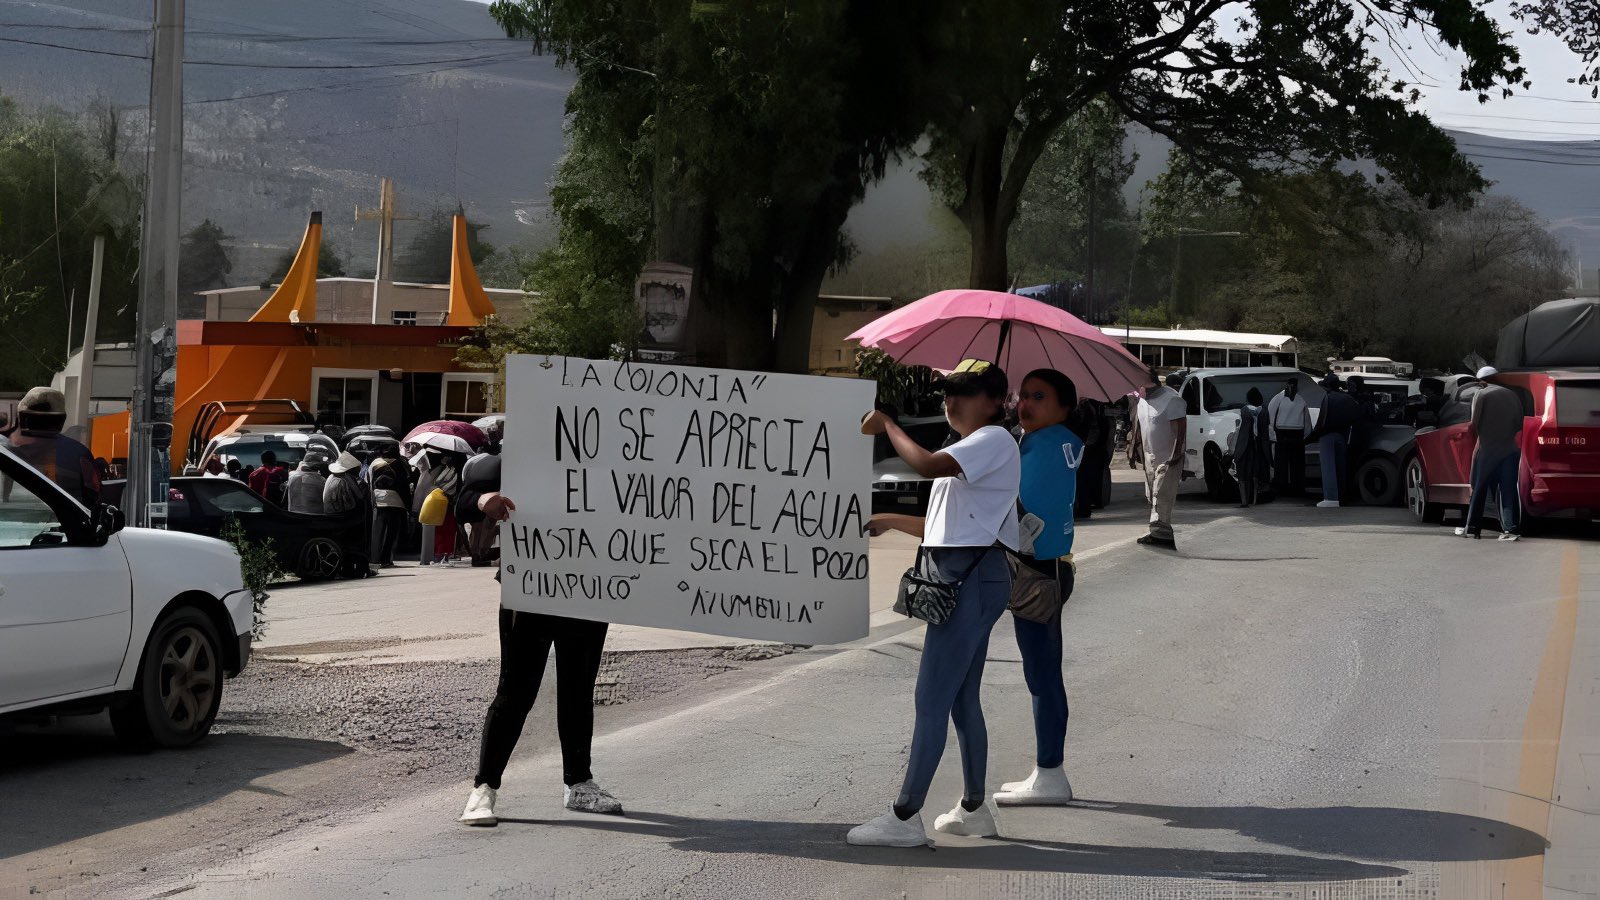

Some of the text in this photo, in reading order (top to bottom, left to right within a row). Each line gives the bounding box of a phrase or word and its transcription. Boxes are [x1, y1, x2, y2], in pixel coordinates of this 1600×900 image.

[555, 406, 831, 480] NO SE APRECIA
[566, 468, 864, 540] EL VALOR DEL AGUA
[511, 523, 597, 561] HASTA
[608, 528, 670, 565] QUE
[811, 546, 869, 580] POZO
